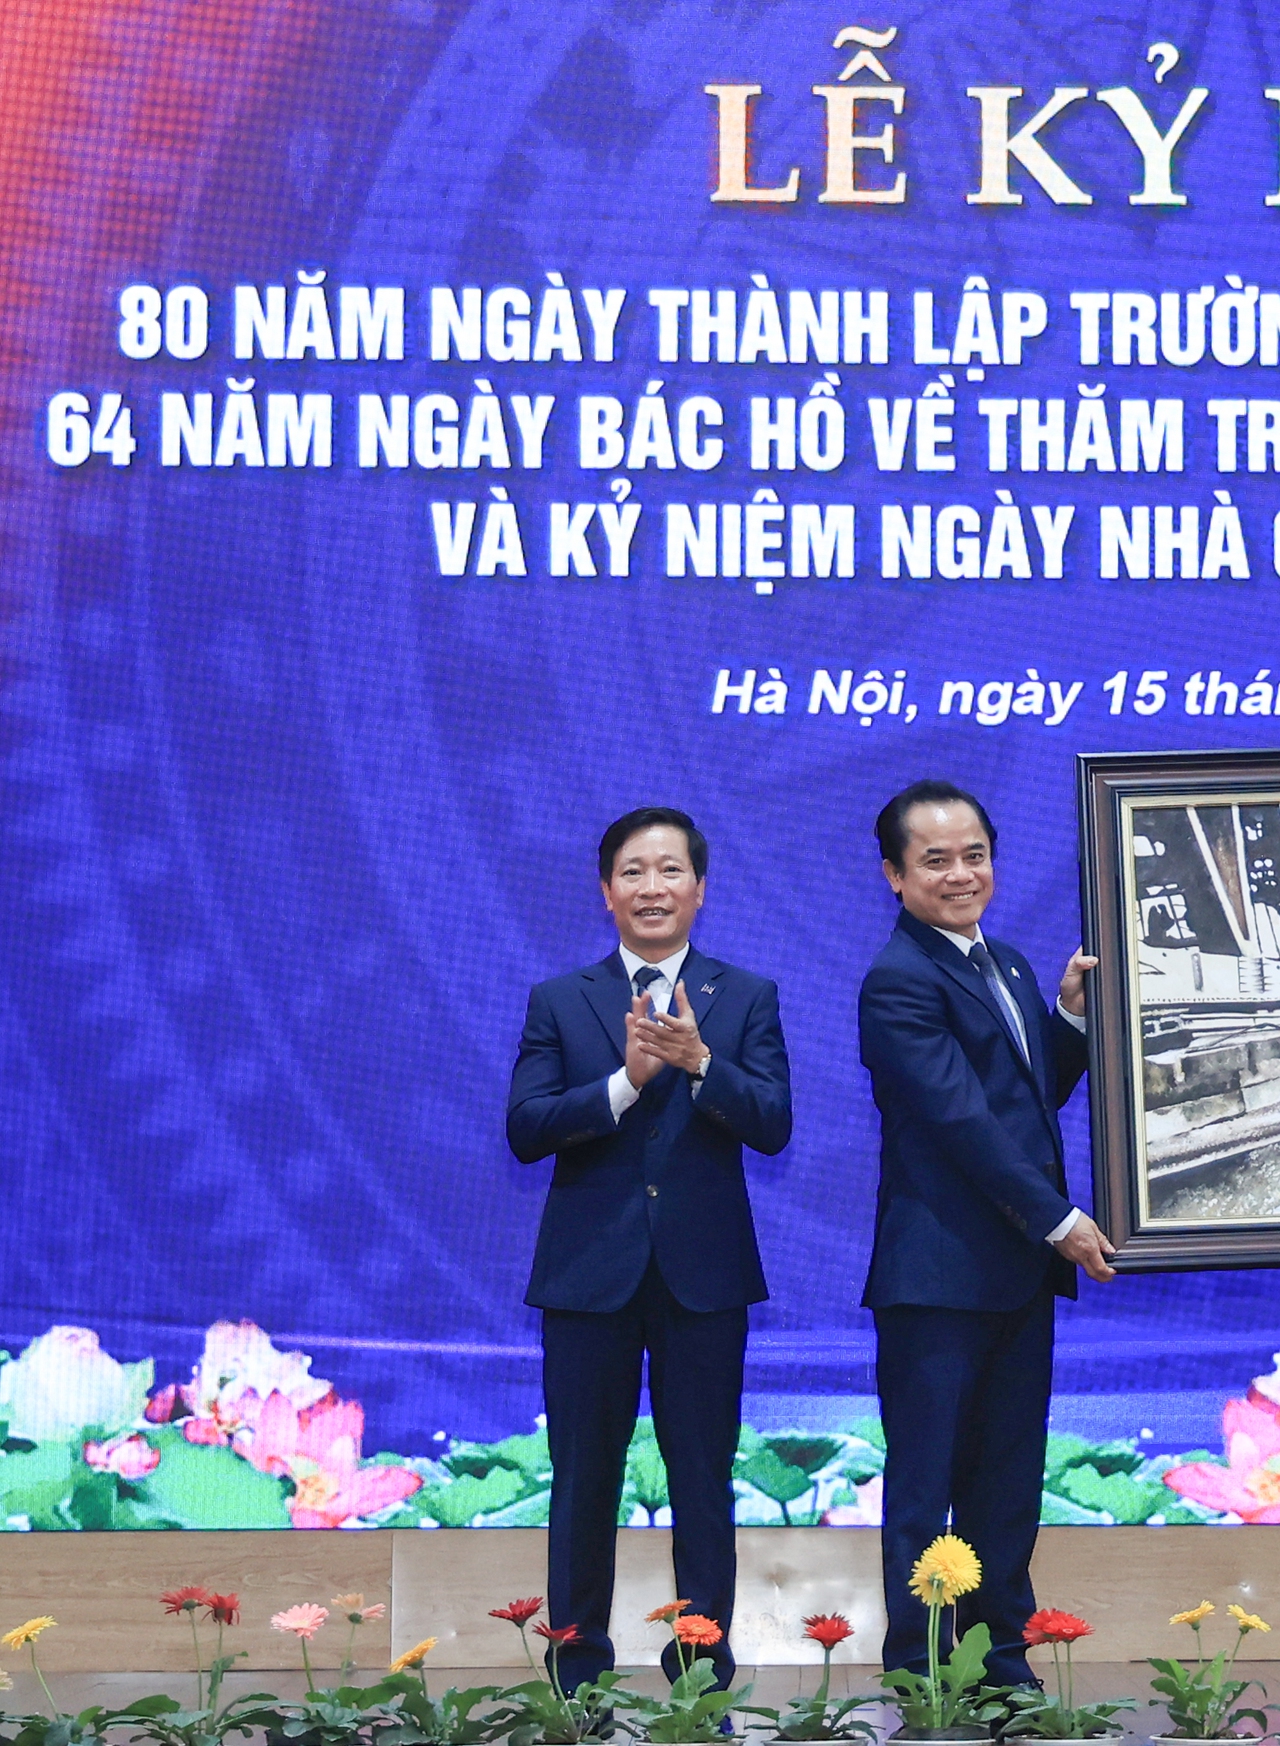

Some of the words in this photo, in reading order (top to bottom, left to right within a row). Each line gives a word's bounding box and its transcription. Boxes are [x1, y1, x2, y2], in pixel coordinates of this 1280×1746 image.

[703, 26, 907, 204] LỄ
[966, 41, 1209, 206] KỶ
[118, 284, 208, 360] 80
[234, 269, 405, 361] NĂM
[429, 271, 627, 362] NGÀY
[647, 272, 889, 365] THÀNH
[912, 274, 1048, 382] LẬP
[47, 391, 136, 467] 64
[160, 377, 333, 468] NĂM
[357, 378, 556, 469] NGÀY
[578, 379, 724, 471] BÁC
[749, 371, 845, 472] HỒ
[867, 373, 956, 472] VỀ
[978, 382, 1184, 473] THĂM
[429, 486, 527, 577] VÀ
[548, 477, 642, 577] KỶ
[665, 488, 855, 595] NIỆM
[880, 489, 1076, 580] NGÀY
[1099, 489, 1251, 579] NHÀ
[711, 667, 788, 715] Hà
[807, 669, 918, 727] Nội,
[938, 668, 1084, 726] ngày
[1103, 670, 1168, 716] 15
